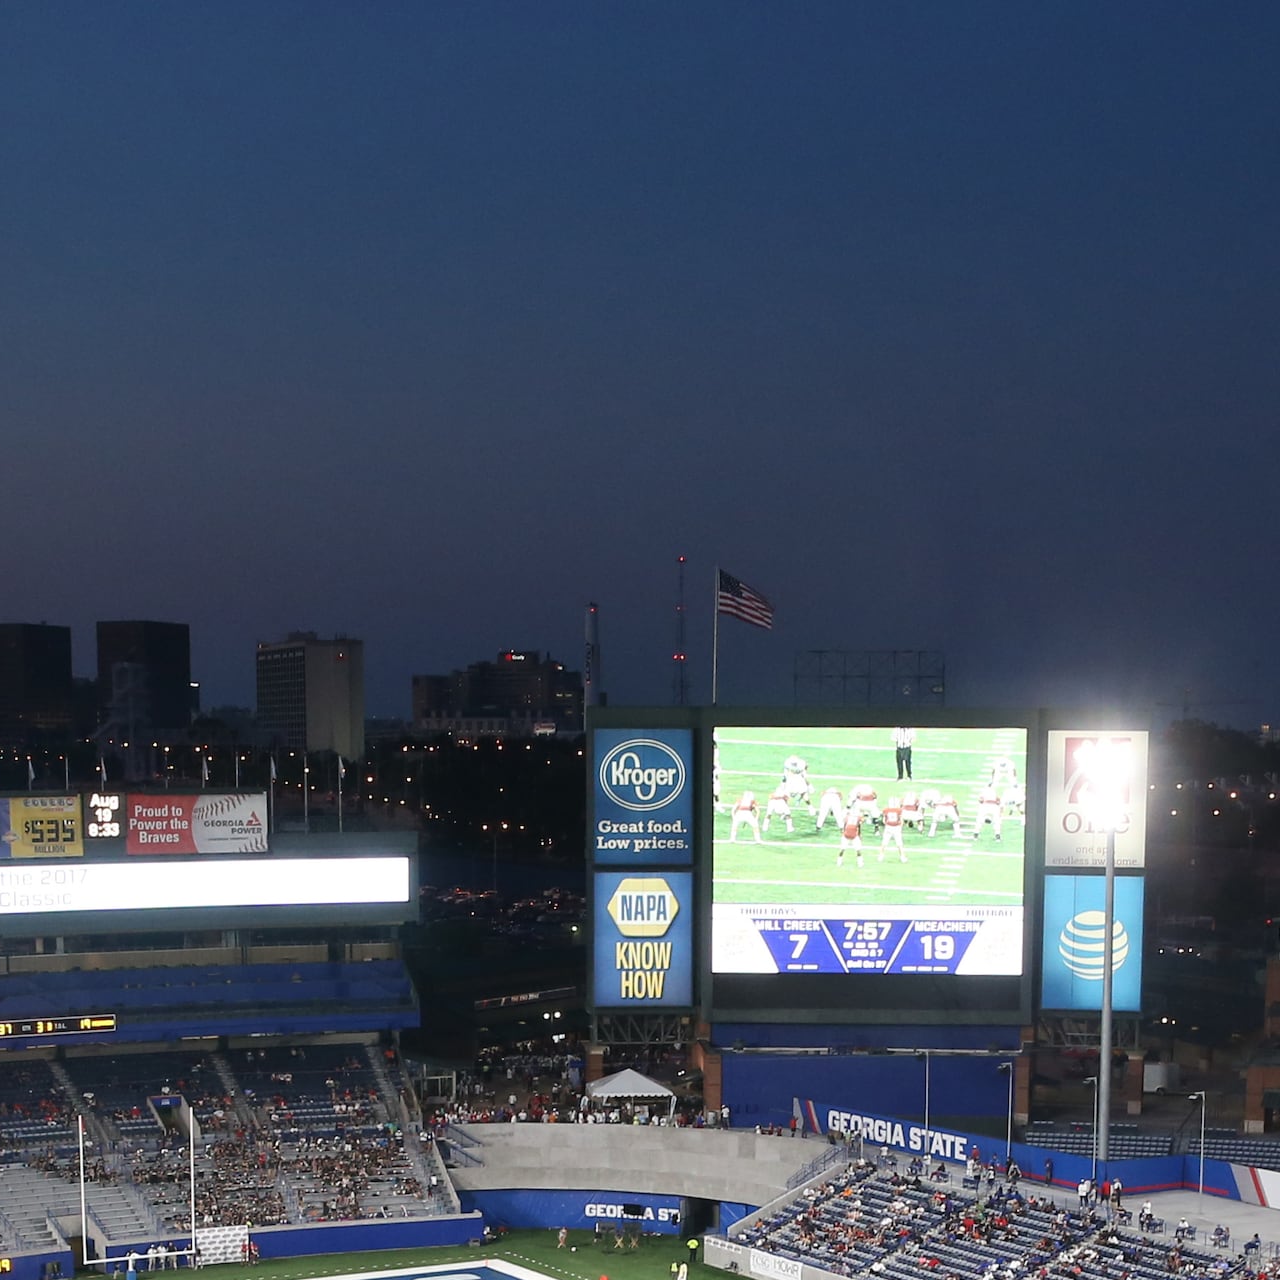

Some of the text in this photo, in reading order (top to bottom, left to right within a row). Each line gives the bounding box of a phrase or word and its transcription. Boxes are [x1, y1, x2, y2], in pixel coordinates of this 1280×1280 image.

[611, 752, 677, 800] Kroger
[89, 793, 119, 809] Aug
[95, 808, 113, 822] 19
[135, 805, 183, 818] Proud to
[88, 823, 120, 837] 8:33
[129, 818, 189, 830] Power the
[204, 819, 244, 828] GEORGIA
[598, 820, 687, 833] Great food.
[139, 831, 180, 844] Braves
[597, 836, 689, 852] Low prices.
[34, 845, 66, 854] MILLION
[0, 871, 33, 886] the
[40, 869, 88, 886] 2017
[620, 895, 667, 921] NAPA
[784, 920, 821, 931] CREEK
[843, 922, 891, 941] 7:57
[914, 920, 982, 932] MCEACHERN
[788, 934, 808, 959] 7
[920, 935, 955, 959] 19
[615, 942, 672, 970] KNOW
[621, 971, 665, 999] HOW
[828, 1110, 968, 1161] GEORGIA STATE
